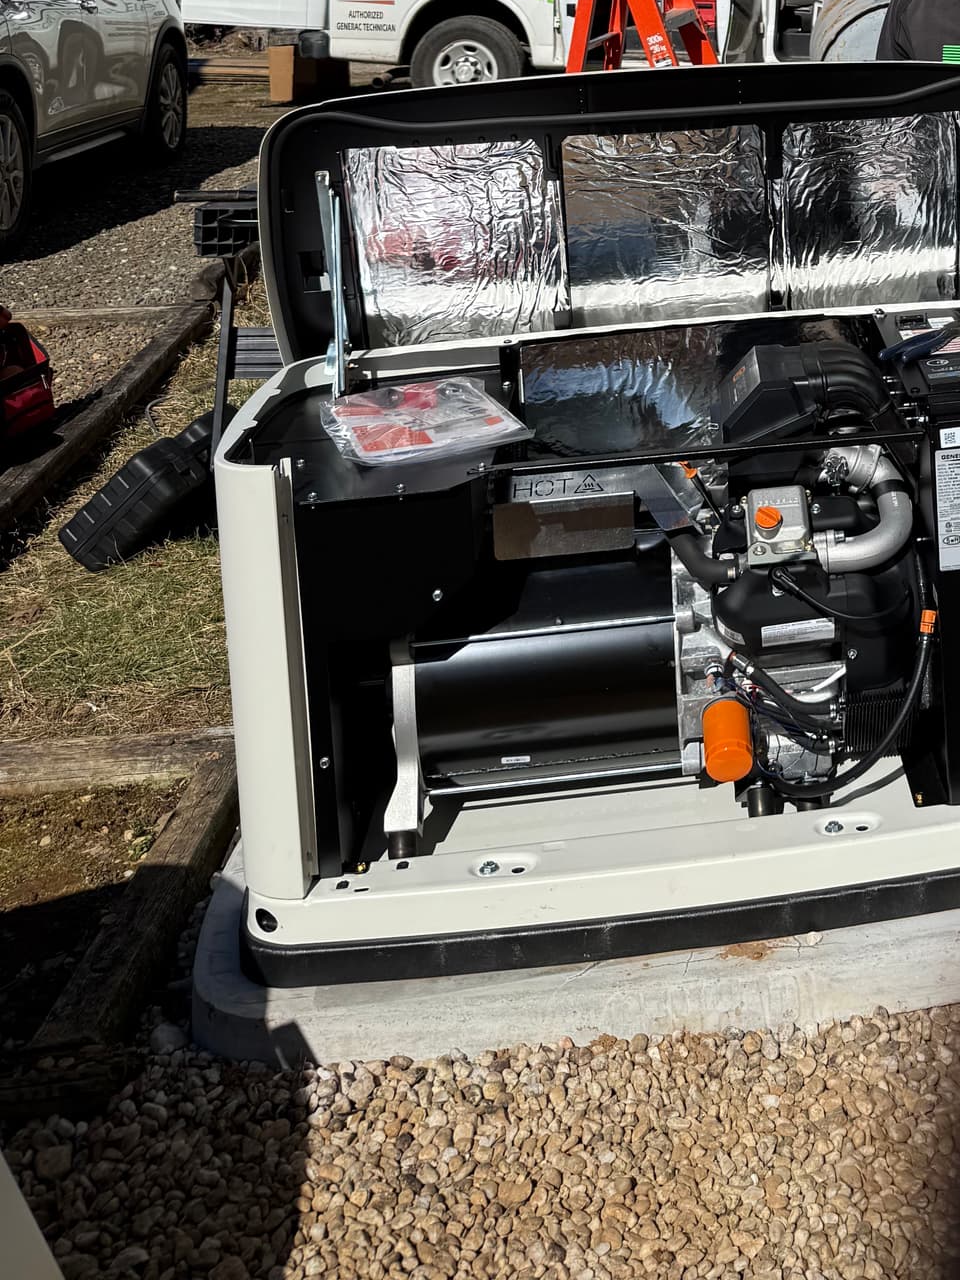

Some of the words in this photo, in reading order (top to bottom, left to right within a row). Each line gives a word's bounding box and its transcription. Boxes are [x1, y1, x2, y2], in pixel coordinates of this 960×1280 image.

[348, 10, 384, 19] AUTHORIZED
[336, 22, 362, 31] GENERAC
[363, 23, 396, 32] TECHNICIAN
[513, 477, 575, 498] HOT
